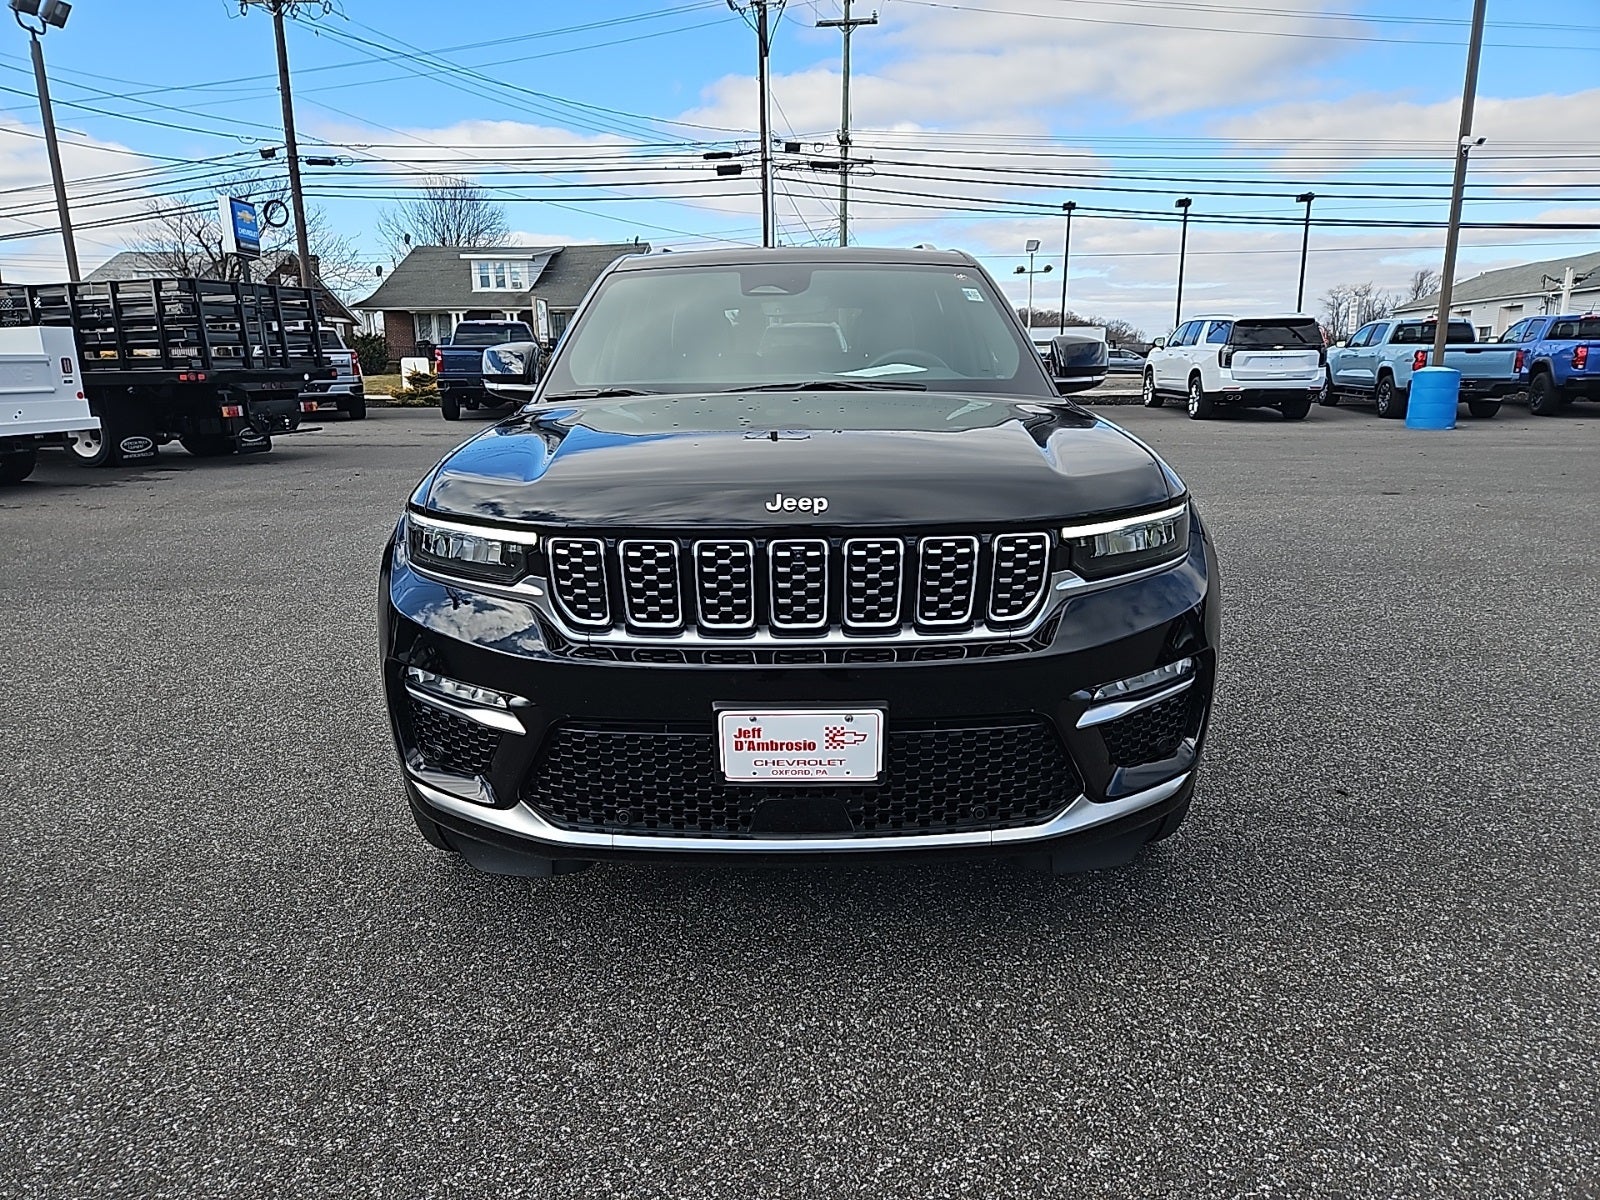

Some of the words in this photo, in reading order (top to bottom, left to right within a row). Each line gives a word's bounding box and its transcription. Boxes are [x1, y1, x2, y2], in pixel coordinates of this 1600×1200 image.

[765, 492, 829, 515] Jeep
[733, 727, 762, 739] Jeff
[734, 740, 817, 752] D'Ambrosio
[753, 759, 846, 767] CHEVROLET
[771, 769, 813, 777] OXFORD,
